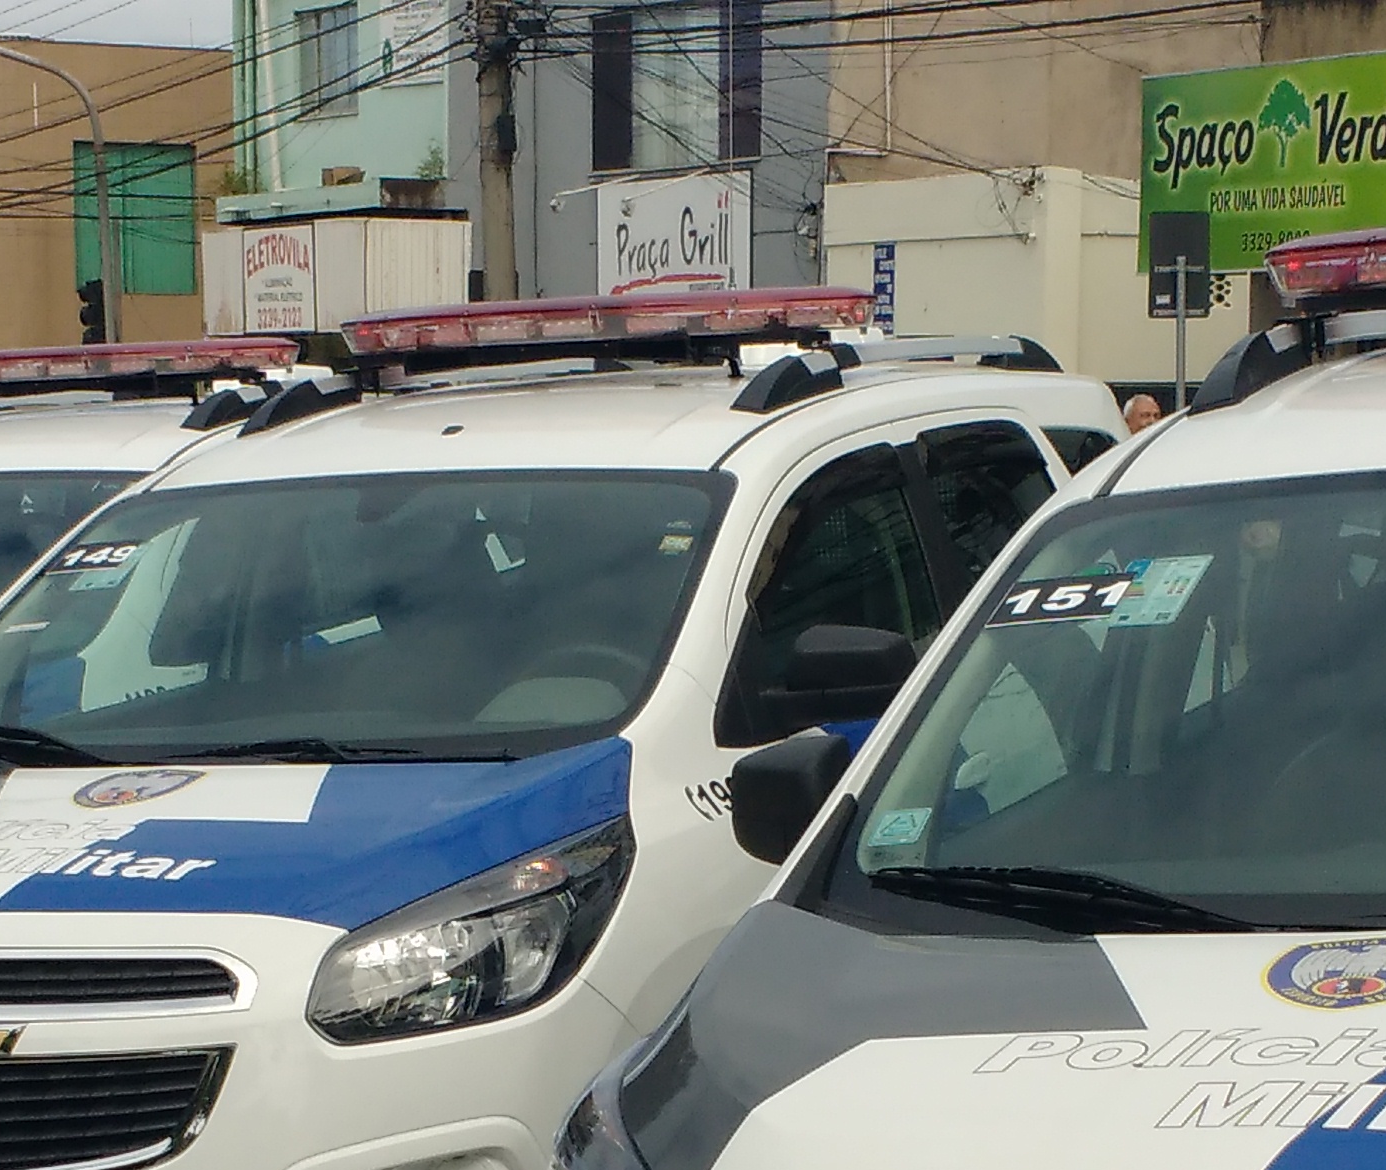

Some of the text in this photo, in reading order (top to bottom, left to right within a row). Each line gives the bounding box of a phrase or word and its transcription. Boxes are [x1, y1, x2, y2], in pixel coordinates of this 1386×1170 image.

[1153, 103, 1254, 190] Spaço
[1210, 178, 1346, 213] POR UMA VIDA SAUDÁVEL
[616, 191, 729, 279] Praça Grill
[246, 234, 311, 279] ELETROVILA
[63, 545, 137, 567] 149
[1005, 580, 1132, 616] 151
